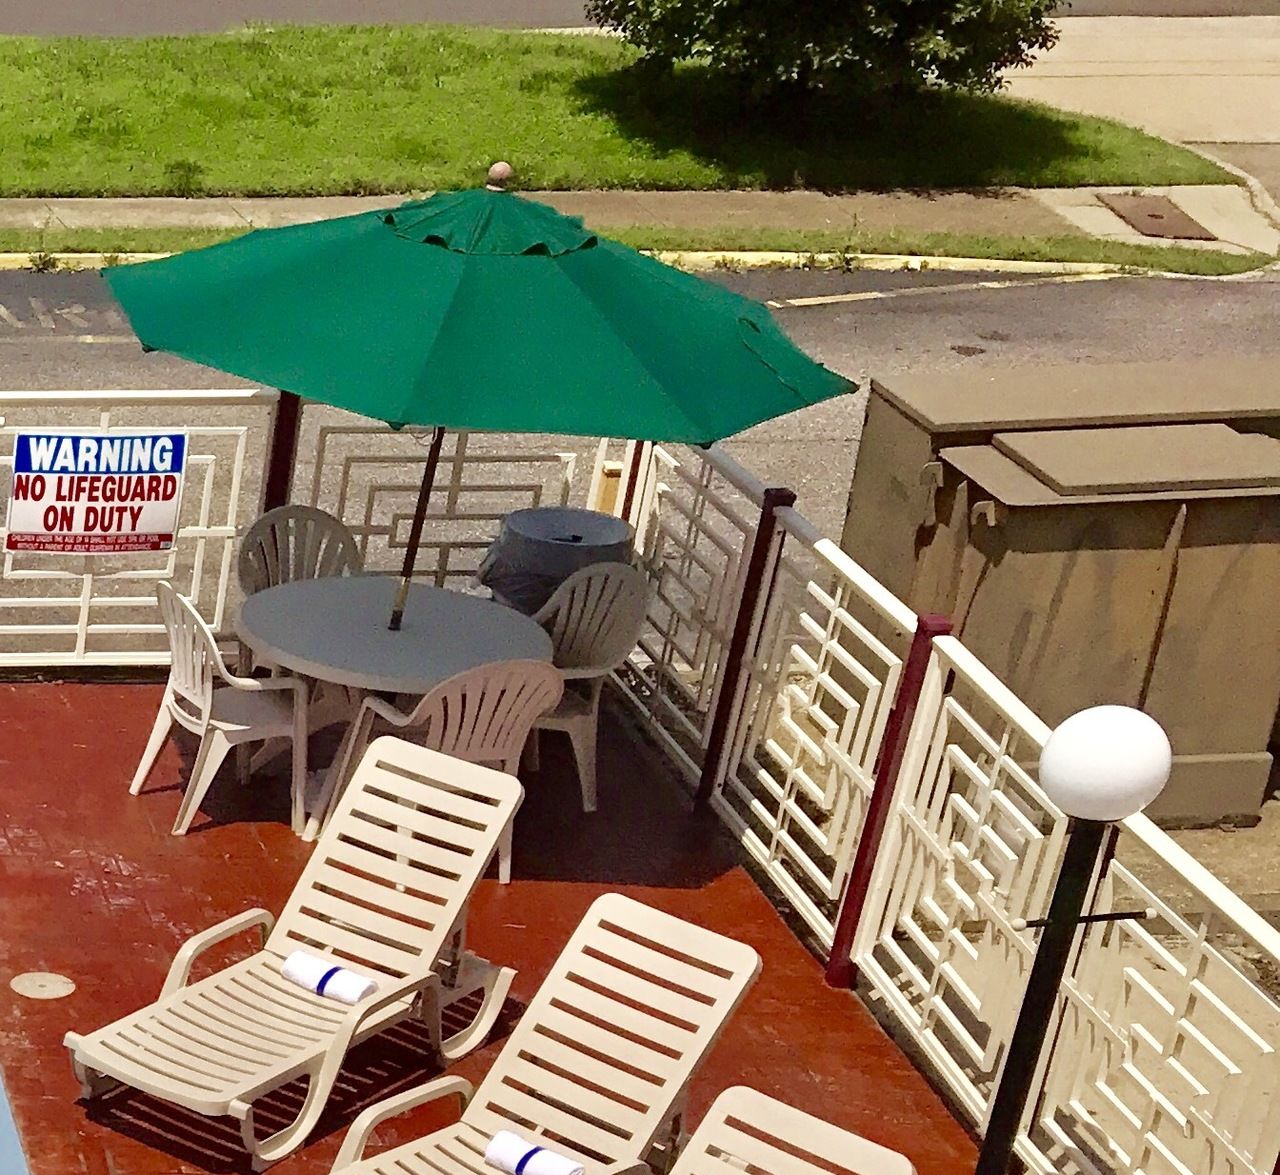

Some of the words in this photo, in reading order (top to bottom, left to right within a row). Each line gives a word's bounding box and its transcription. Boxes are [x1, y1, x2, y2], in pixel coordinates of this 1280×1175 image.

[29, 436, 174, 473] WARNING
[14, 474, 46, 501] NO
[56, 474, 177, 502] LIFEGUARD
[43, 505, 75, 532] ON
[83, 505, 143, 532] DUTY
